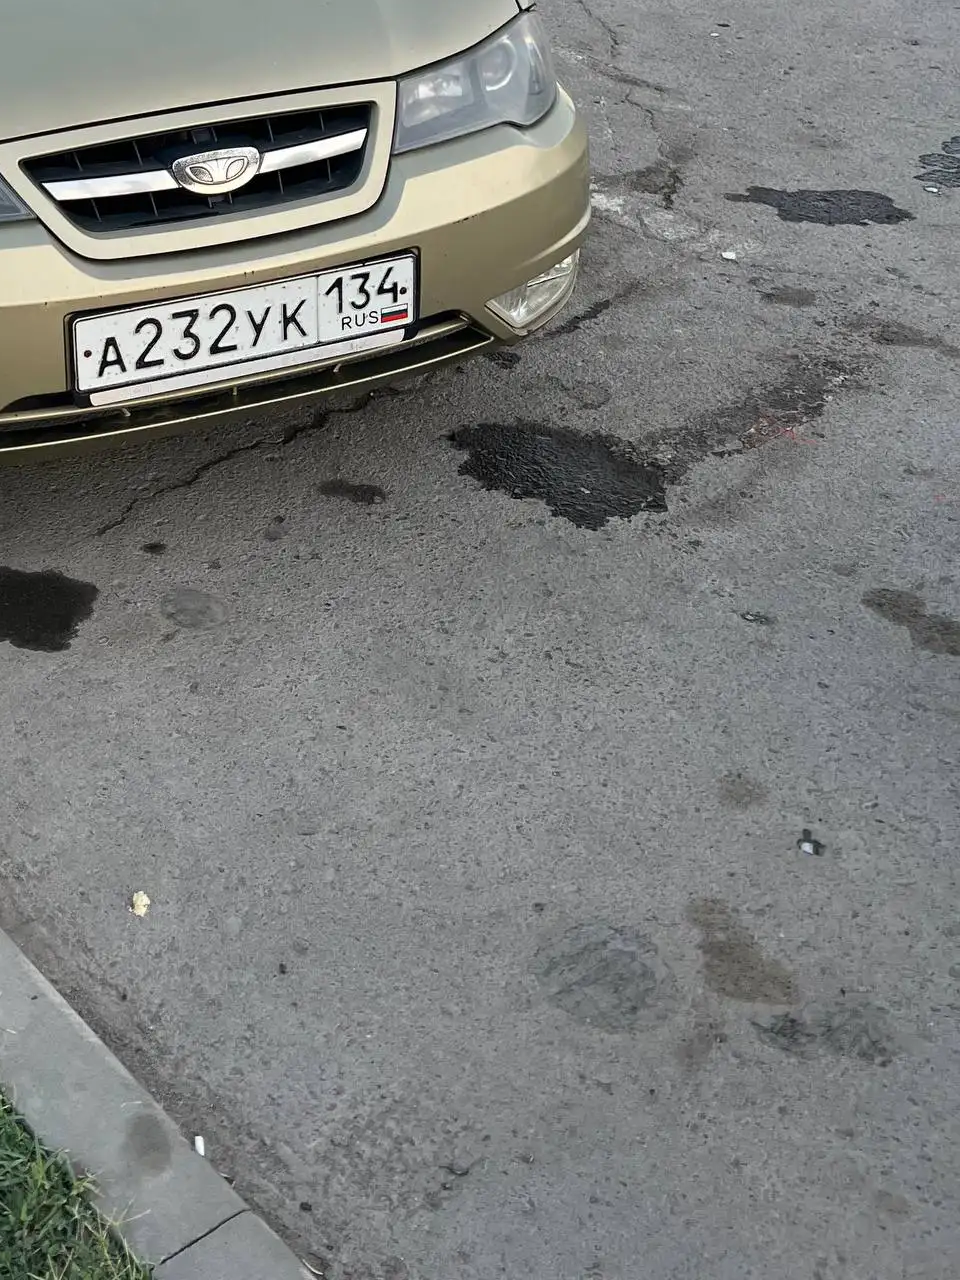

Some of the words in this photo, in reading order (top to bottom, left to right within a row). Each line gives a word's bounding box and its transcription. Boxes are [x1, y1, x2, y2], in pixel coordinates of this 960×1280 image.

[97, 298, 307, 378] А232УК
[324, 265, 399, 314] 134
[341, 310, 380, 331] RUS
